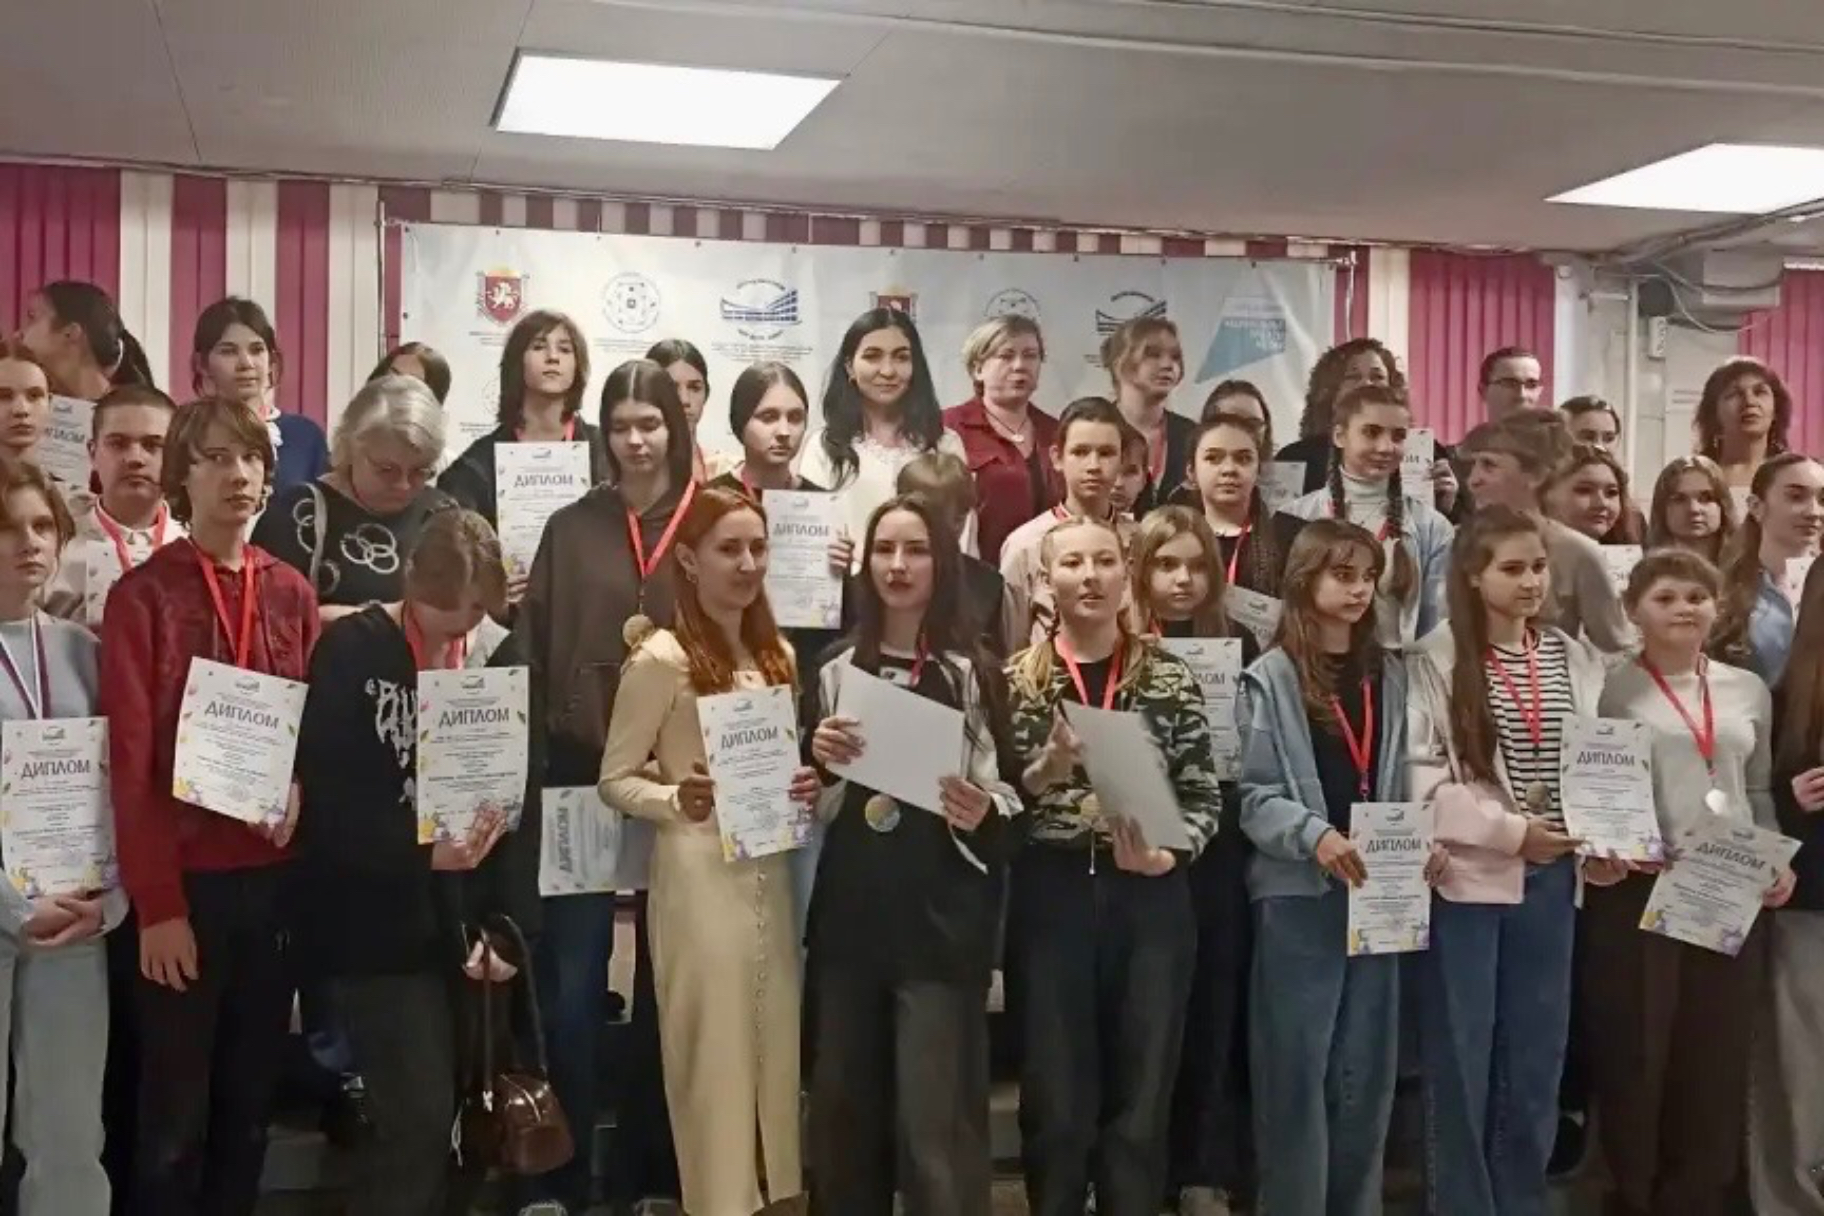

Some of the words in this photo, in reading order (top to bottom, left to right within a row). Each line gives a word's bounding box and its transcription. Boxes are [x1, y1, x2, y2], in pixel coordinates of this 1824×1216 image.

[45, 427, 85, 443] ПЛОМ
[514, 475, 573, 488] ДИПЛОМ
[774, 523, 829, 536] ДИПЛОМ
[205, 701, 279, 729] ДИПЛОМ
[439, 708, 510, 728] ДИПЛОМ
[722, 726, 779, 749] ДИПЛОМ
[1577, 751, 1635, 766] ДИПЛОМ
[21, 760, 91, 779] ДИПЛОМ
[557, 807, 573, 873] ДИПЛОМ
[1365, 839, 1422, 853] ДИПЛОМ
[1695, 842, 1766, 870] ДИПЛОМ
